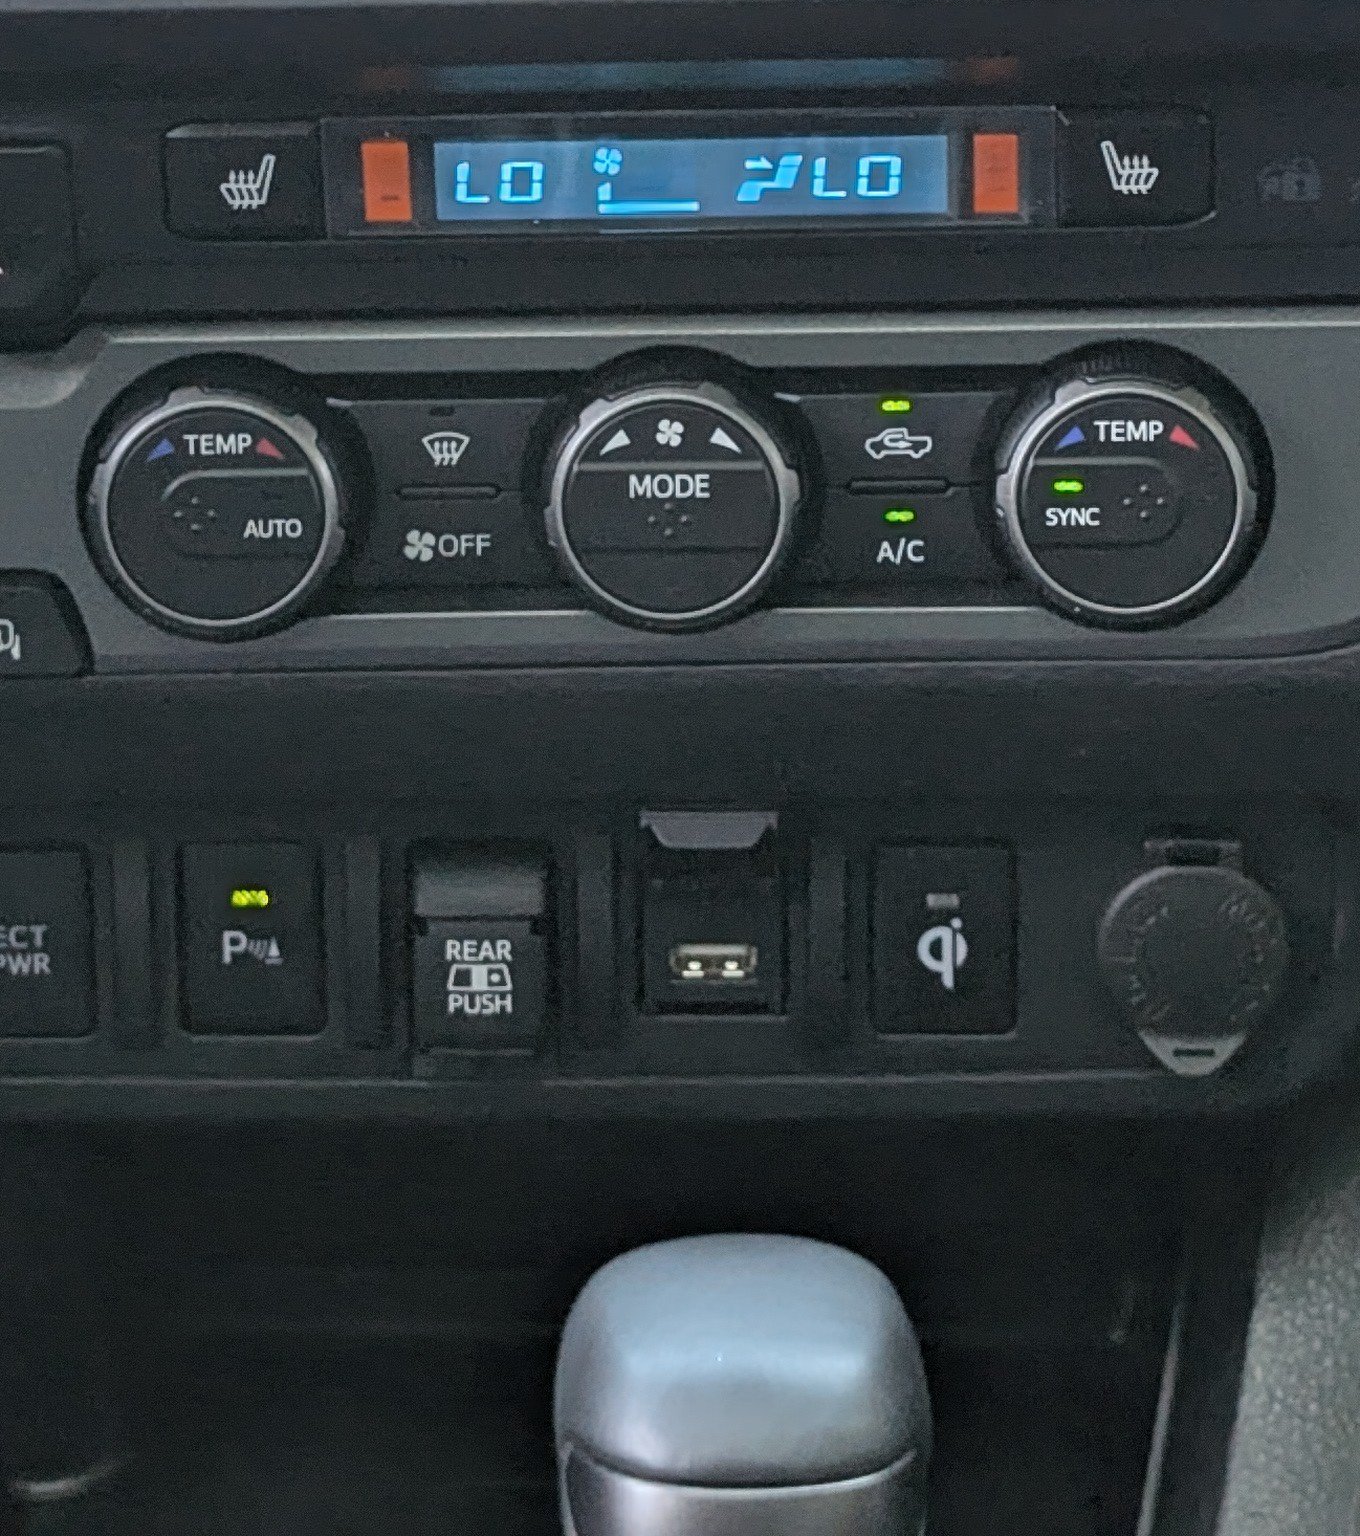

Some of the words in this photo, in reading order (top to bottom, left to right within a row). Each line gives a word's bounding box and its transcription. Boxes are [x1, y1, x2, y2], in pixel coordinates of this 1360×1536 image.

[1093, 421, 1164, 444] TEMP
[183, 434, 253, 456] TEMP
[628, 474, 711, 501] MODE
[1045, 507, 1101, 528] SYNC
[243, 519, 303, 539] AUTO
[438, 534, 491, 557] OFF
[876, 538, 926, 565] A/C
[446, 939, 512, 960] REAR
[447, 993, 513, 1014] PUSH
